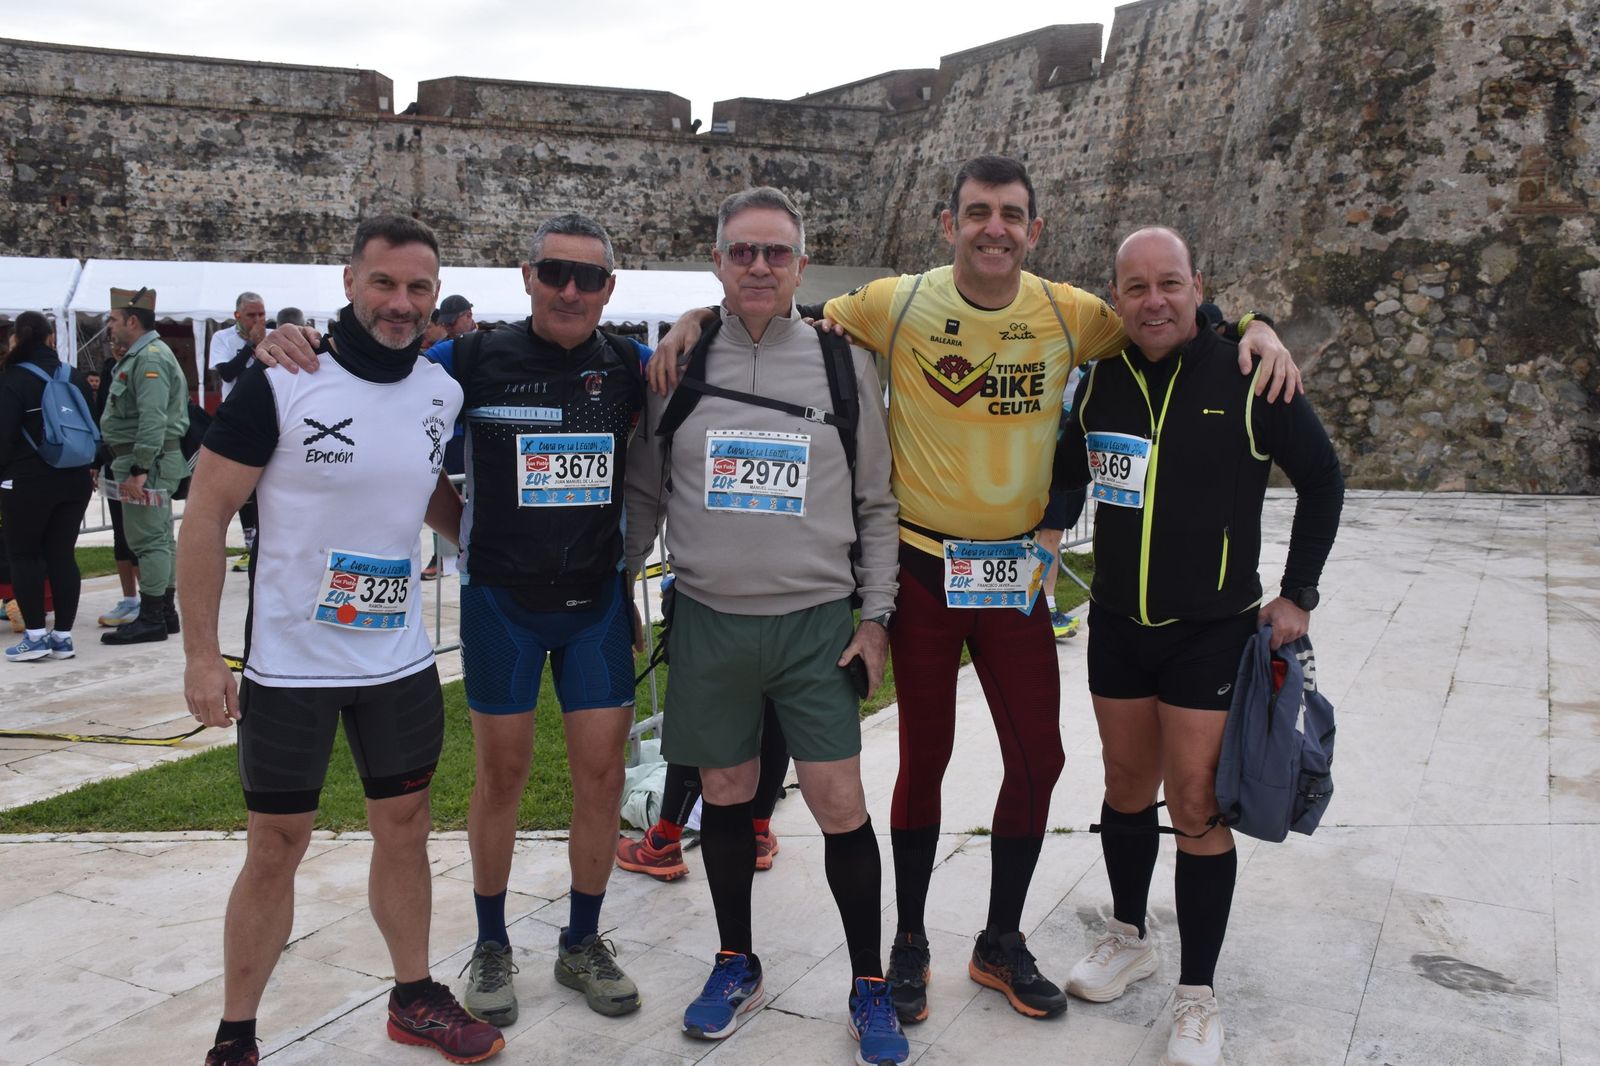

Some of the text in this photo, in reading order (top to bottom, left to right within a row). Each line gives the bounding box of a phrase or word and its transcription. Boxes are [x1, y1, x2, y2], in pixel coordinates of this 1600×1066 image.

[930, 335, 962, 347] BALEARIA
[999, 331, 1036, 340] Zurita
[996, 362, 1045, 374] TITANES
[980, 374, 1045, 398] BIKE
[988, 399, 1041, 415] CEUTA
[305, 449, 353, 464] EDICIÓN
[555, 454, 607, 480] 3678
[740, 460, 800, 488] 2970
[526, 473, 552, 486] 20K
[712, 475, 738, 489] 20K
[982, 560, 1018, 583] 985
[950, 576, 974, 588] 20K
[325, 589, 356, 606] 20K
[360, 577, 408, 604] 3235
